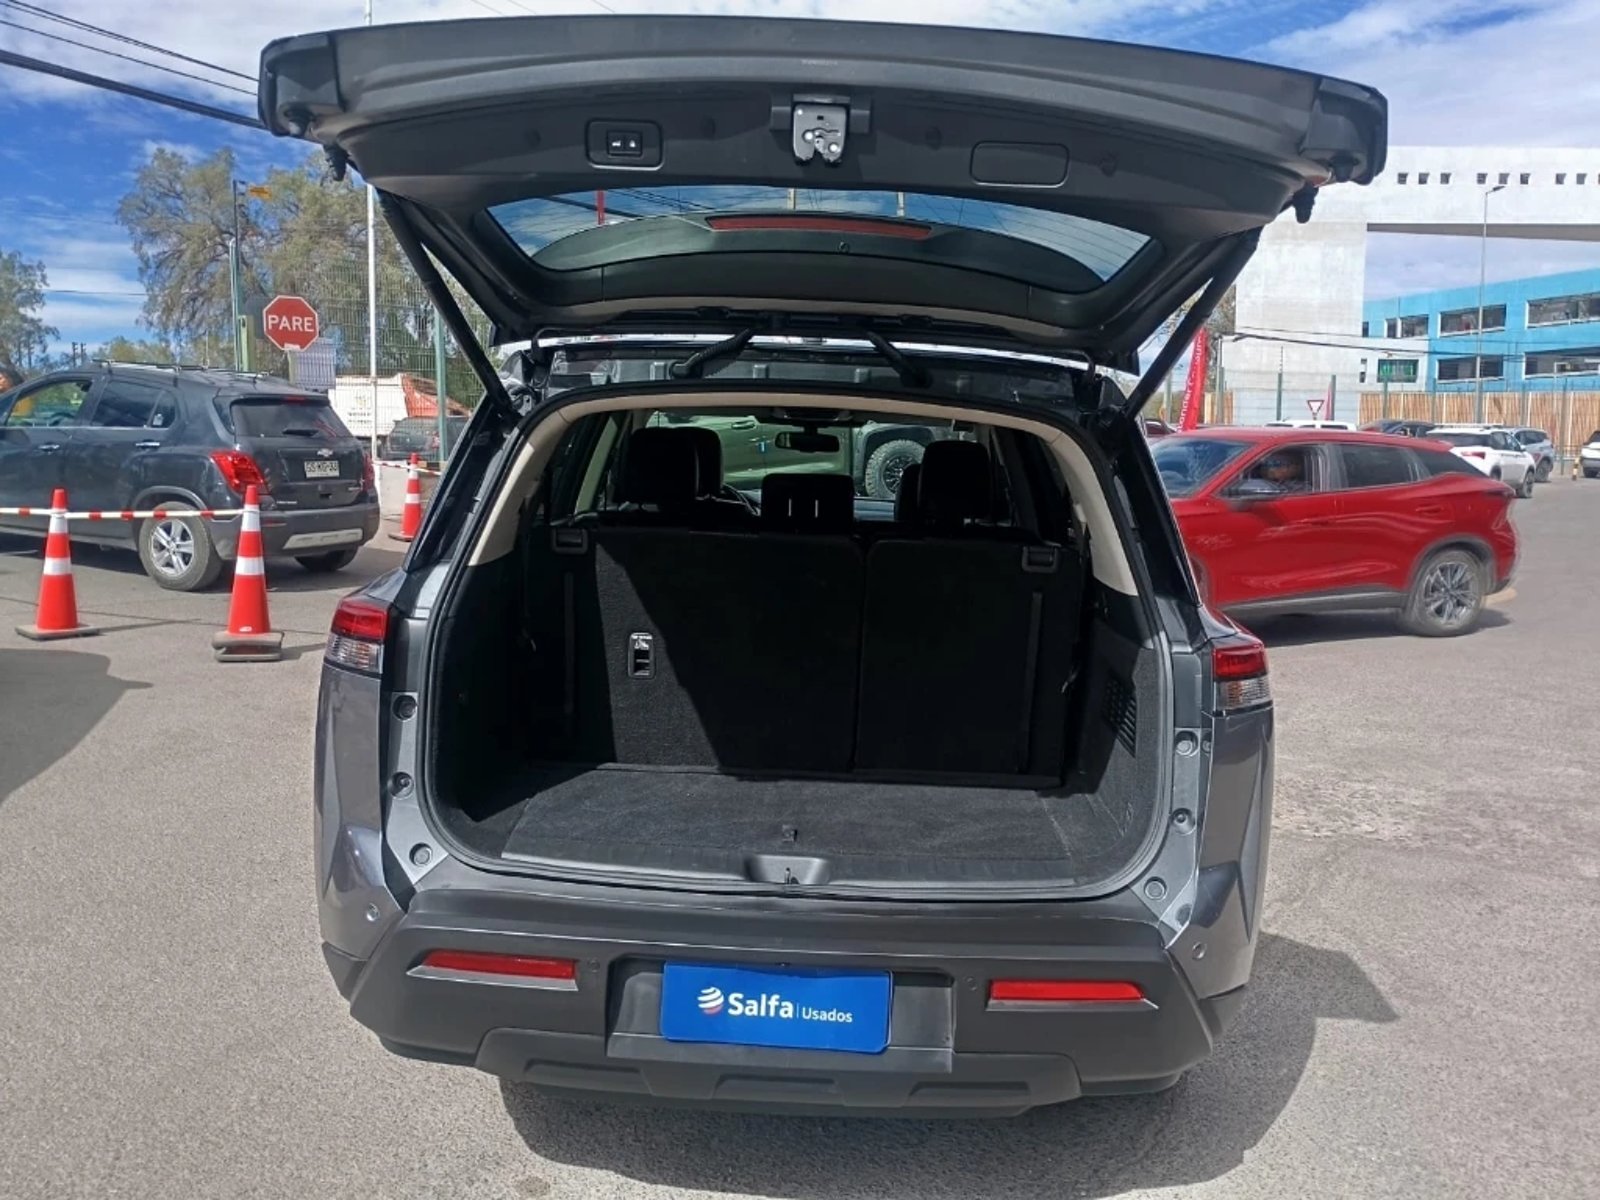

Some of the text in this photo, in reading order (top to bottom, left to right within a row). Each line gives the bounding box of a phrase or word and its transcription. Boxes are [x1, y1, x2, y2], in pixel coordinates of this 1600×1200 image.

[268, 314, 315, 332] PARE
[727, 992, 853, 1023] Salfa Usados
